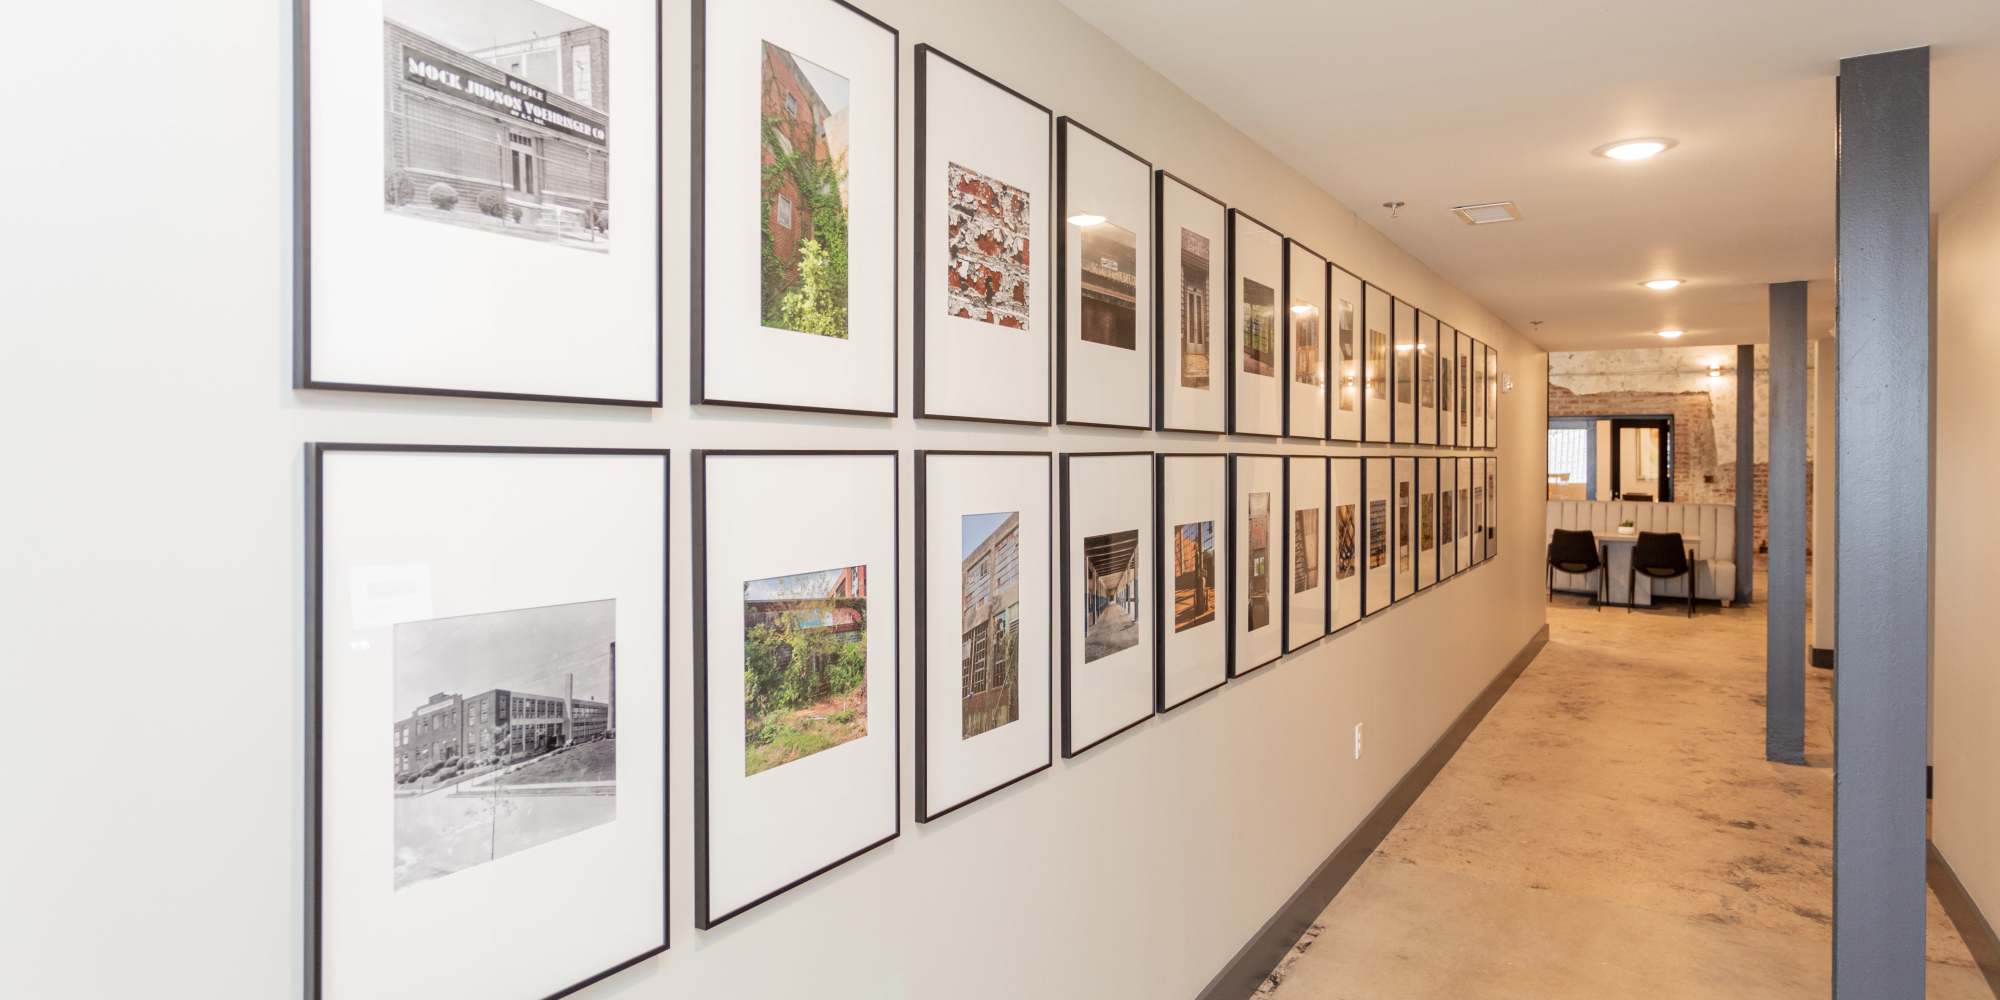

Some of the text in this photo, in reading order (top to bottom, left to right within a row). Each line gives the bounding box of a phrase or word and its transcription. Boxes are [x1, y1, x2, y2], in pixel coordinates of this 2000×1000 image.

[408, 57, 462, 90] MOCK
[464, 80, 522, 111] JUDSON
[523, 101, 592, 136] VOEHRINGER
[592, 127, 605, 140] CO
[509, 80, 544, 101] OFFICE
